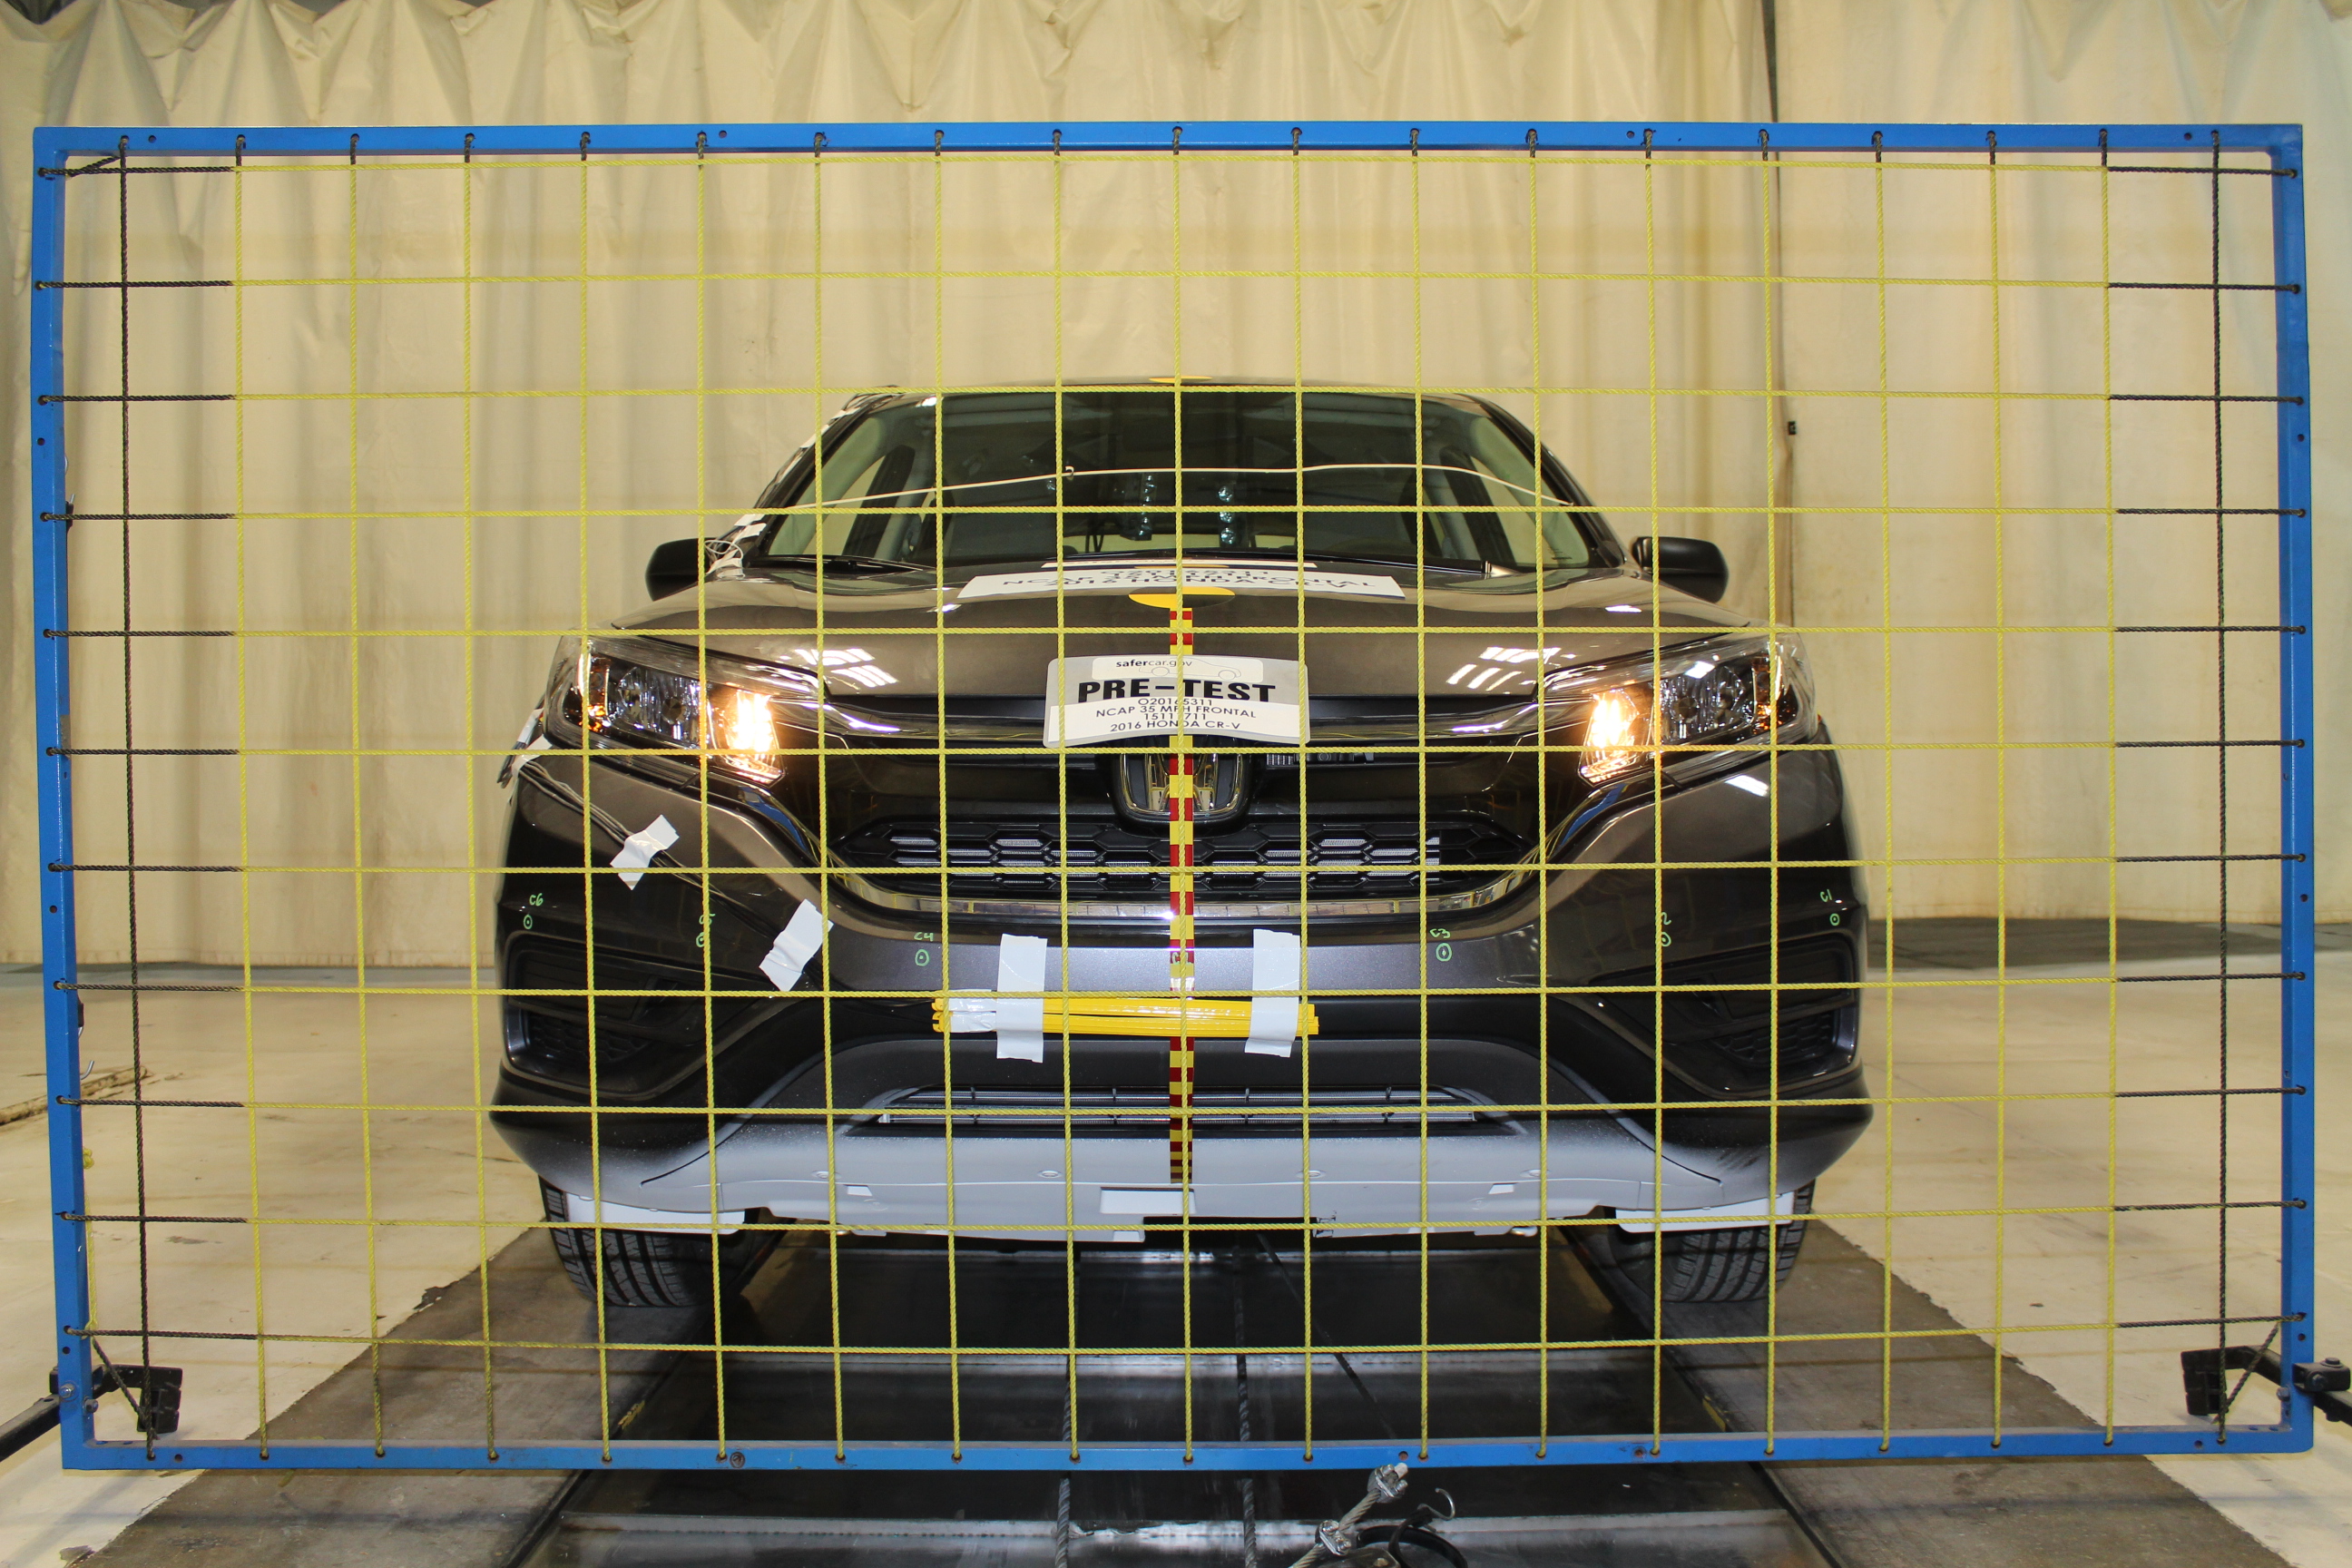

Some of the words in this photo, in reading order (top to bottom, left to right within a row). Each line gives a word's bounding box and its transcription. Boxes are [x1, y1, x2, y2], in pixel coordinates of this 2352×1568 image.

[1115, 659, 1193, 668] safercar.gv
[1078, 678, 1276, 704] PRE-TEST
[1095, 706, 1135, 718] NCAP
[1140, 705, 1156, 713] 35
[1196, 705, 1257, 719] FRONTAL
[1143, 712, 1207, 720] 1511711
[1109, 720, 1142, 732] 2016
[1146, 720, 1200, 729] HONDA
[1204, 720, 1240, 730] CR-V
[529, 893, 544, 906] C6
[914, 931, 934, 942] C4
